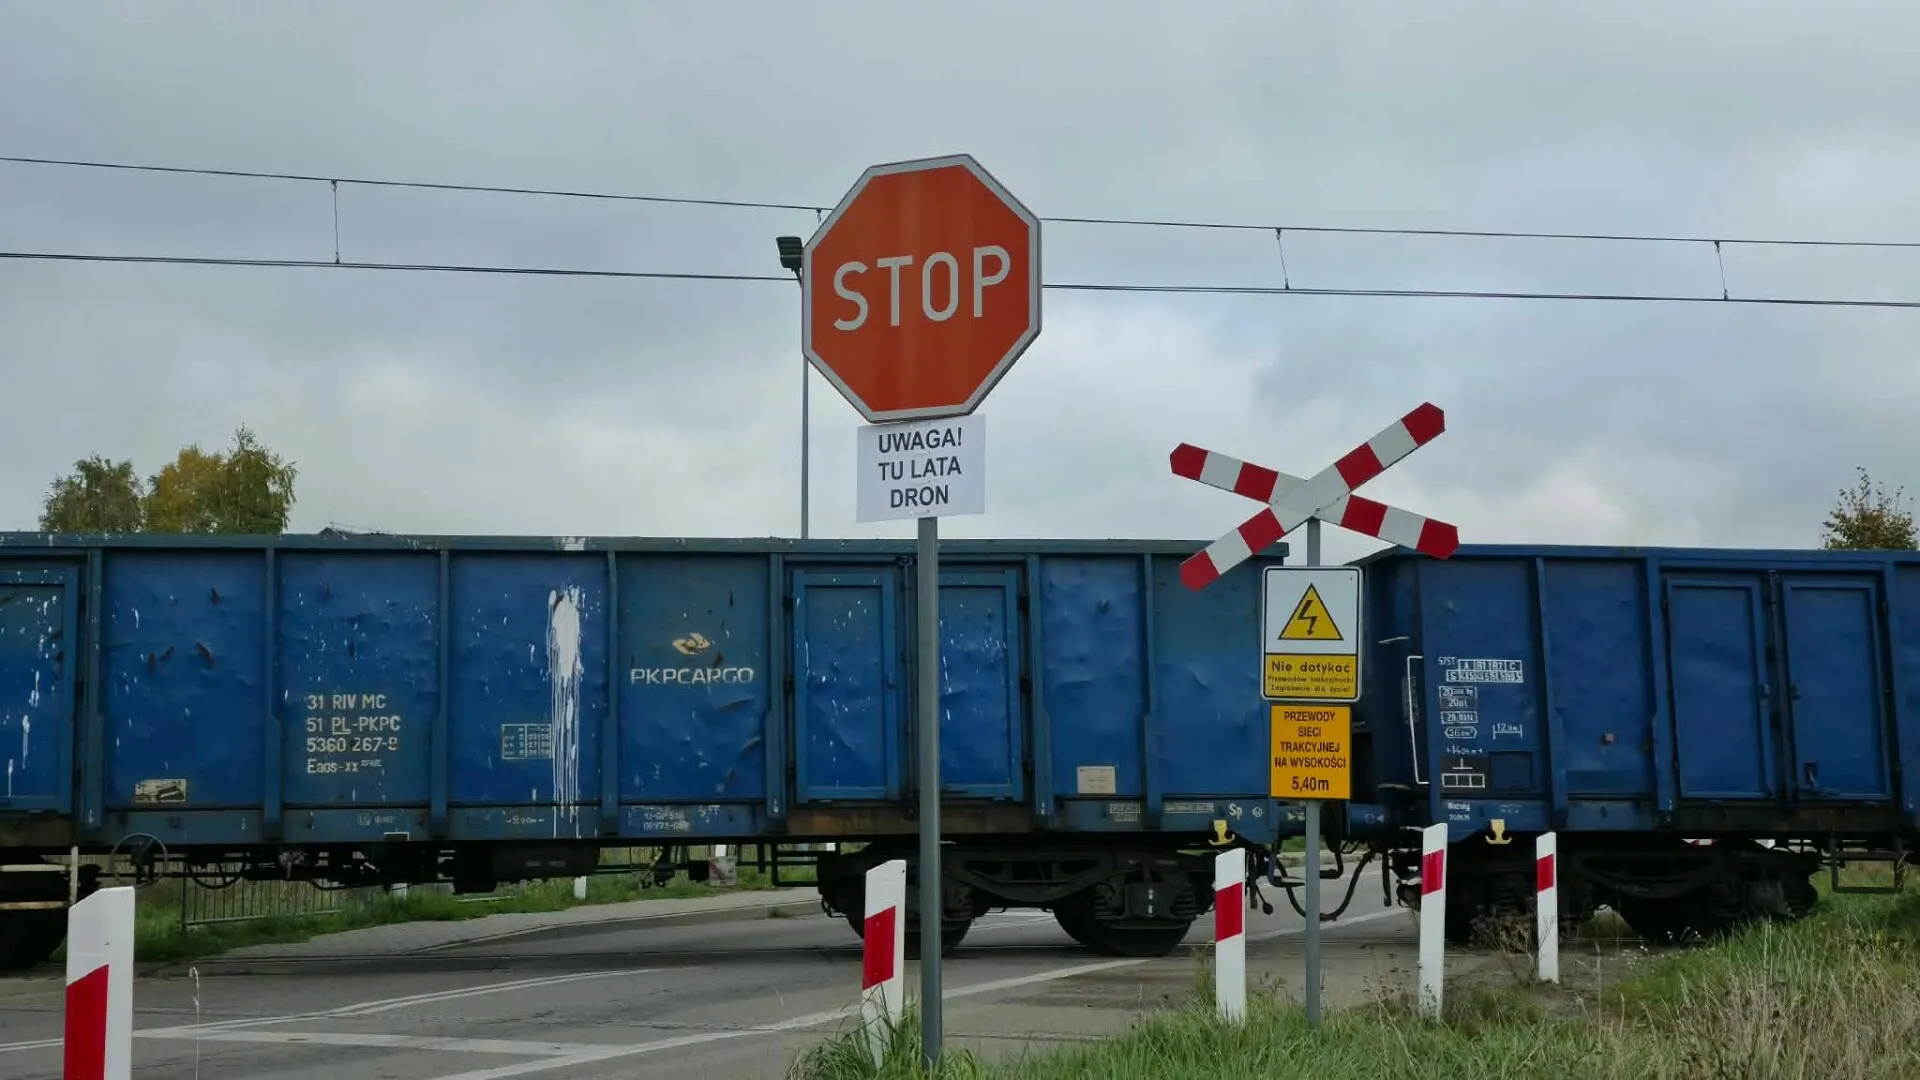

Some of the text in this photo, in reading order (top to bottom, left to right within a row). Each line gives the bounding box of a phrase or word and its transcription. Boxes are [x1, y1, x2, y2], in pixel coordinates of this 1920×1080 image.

[833, 246, 1011, 331] STOP
[878, 427, 962, 454] UWAGA!
[878, 456, 962, 480] TU LATA
[890, 484, 948, 508] DRON
[1272, 661, 1350, 675] Nie dotykać
[307, 694, 386, 710] 31 RIV MC
[1284, 711, 1336, 722] PRZEWODY
[306, 717, 323, 732] 51
[1298, 726, 1322, 737] SIECI
[306, 737, 347, 752] 5360
[1281, 742, 1340, 753] TRAKCYJNEJ
[1274, 755, 1346, 768] NA WYSOKOŚCI
